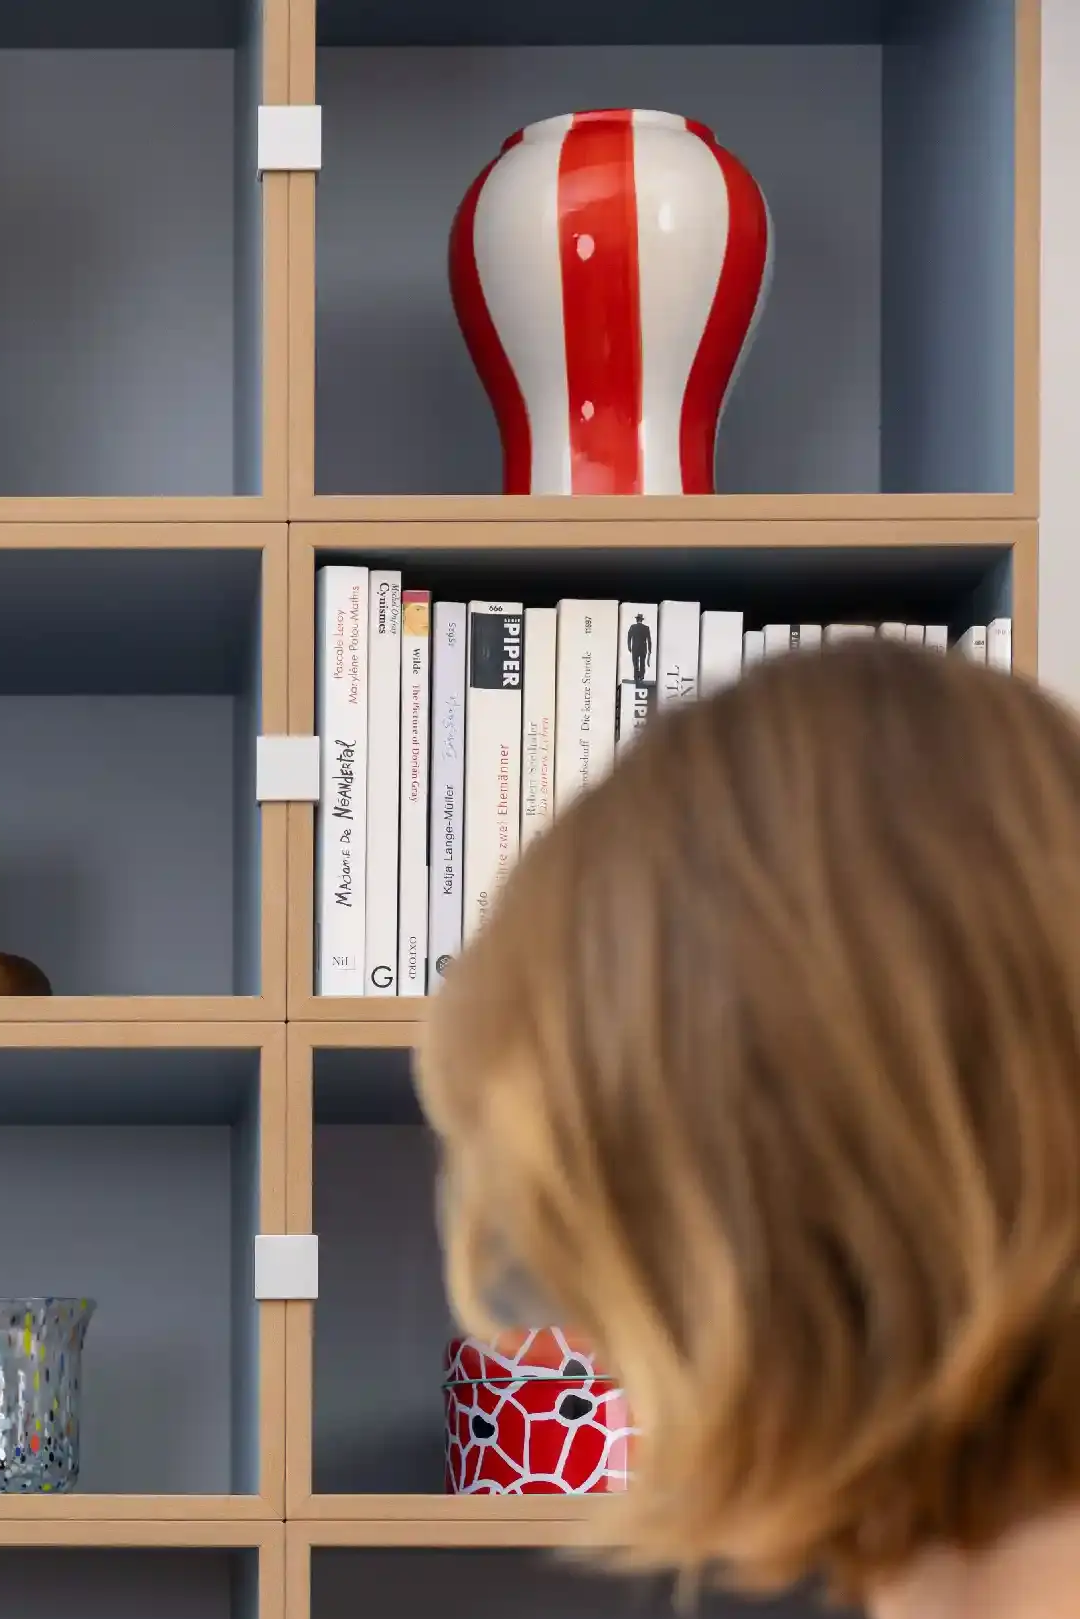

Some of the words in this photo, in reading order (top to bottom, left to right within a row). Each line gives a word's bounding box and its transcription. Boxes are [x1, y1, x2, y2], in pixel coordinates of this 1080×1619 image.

[377, 582, 390, 635] Cynismes
[332, 639, 344, 679] Pascale
[412, 648, 421, 675] Wilde
[503, 623, 520, 687] PIPER
[348, 654, 360, 704] Marylène
[412, 685, 421, 701] The
[580, 686, 592, 712] kurze
[634, 688, 649, 729] PIPE
[411, 702, 421, 734] Picture
[580, 713, 591, 731] Die
[411, 736, 420, 745] of
[410, 748, 420, 779] Dorian
[408, 781, 420, 802] Gray
[497, 744, 510, 815] Ehemänner
[443, 784, 455, 861] Lange-Müller
[497, 820, 508, 849] zwei
[443, 865, 454, 895] Katja
[408, 936, 417, 980] OXFORD
